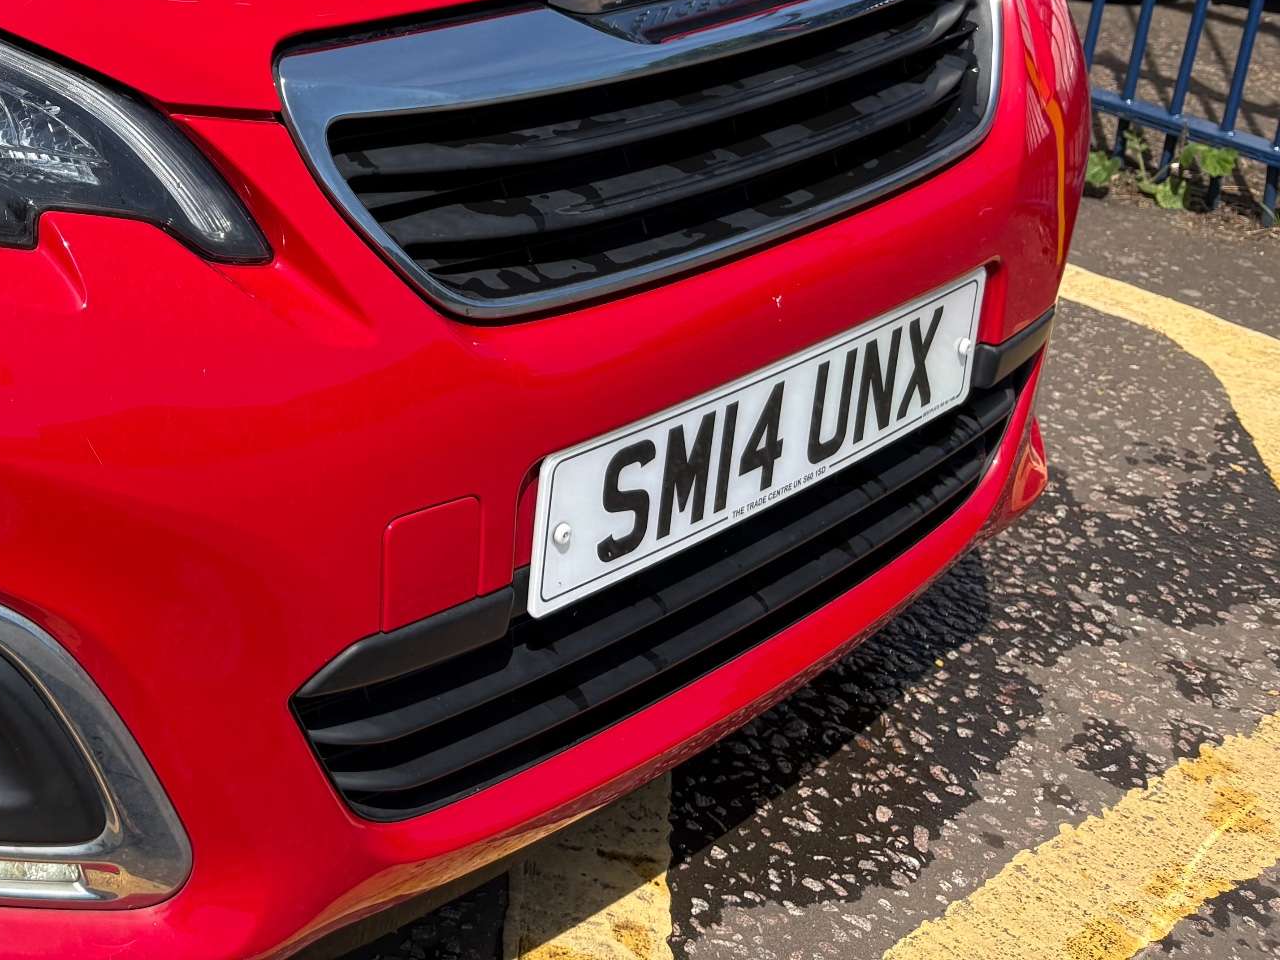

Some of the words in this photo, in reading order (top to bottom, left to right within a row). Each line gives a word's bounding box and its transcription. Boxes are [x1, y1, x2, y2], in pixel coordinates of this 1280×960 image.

[596, 381, 786, 563] SM14
[807, 305, 944, 465] UNX
[732, 506, 745, 519] THE
[746, 495, 767, 512] TRADE
[768, 482, 793, 501] CENTRE
[793, 478, 802, 489] UK
